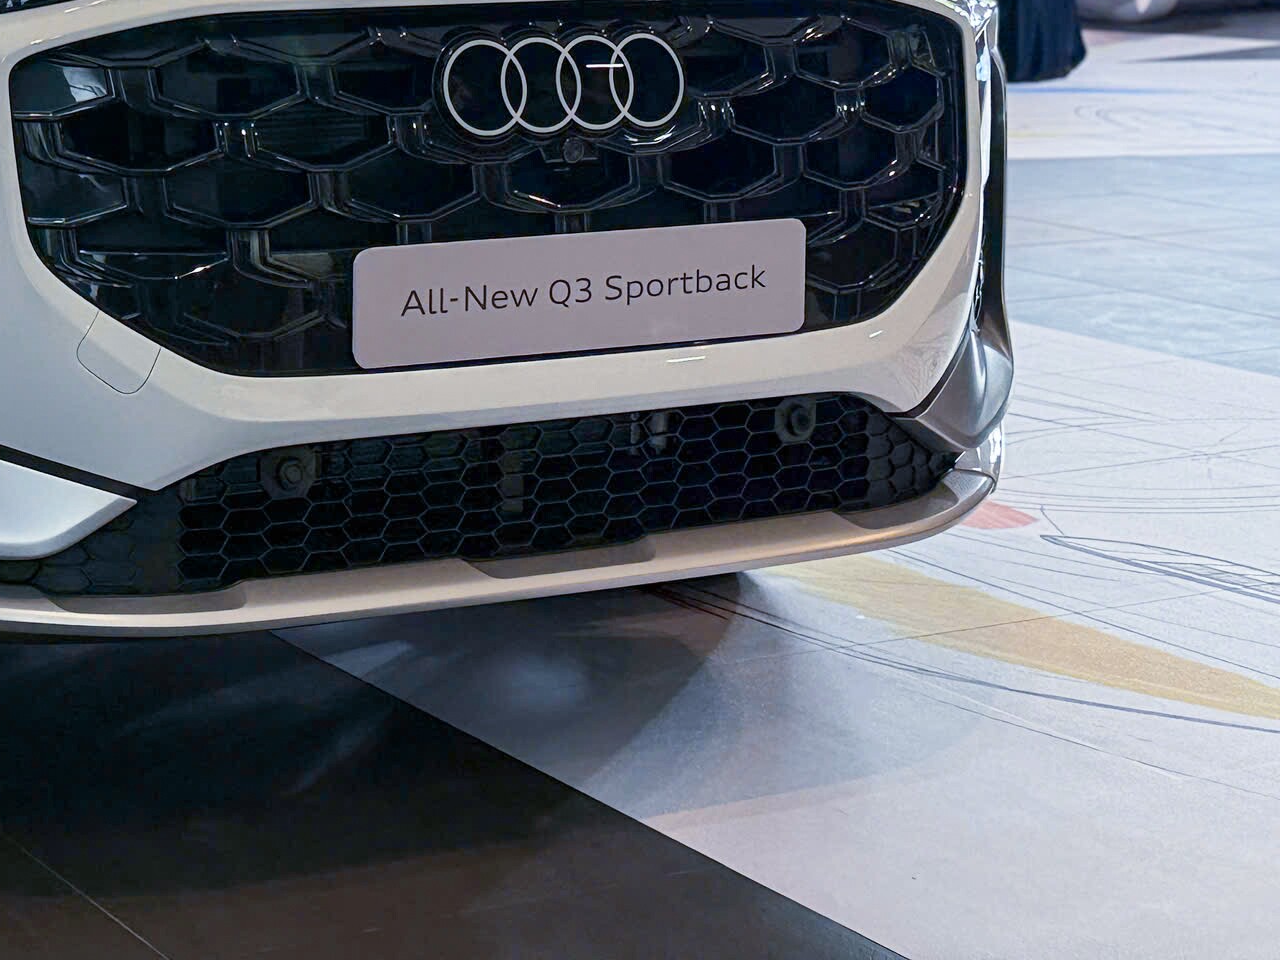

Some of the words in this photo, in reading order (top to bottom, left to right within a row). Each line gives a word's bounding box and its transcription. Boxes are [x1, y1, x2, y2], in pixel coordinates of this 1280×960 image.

[401, 284, 538, 317] All-New
[549, 277, 593, 307] Q3
[605, 264, 766, 306] Sportback
